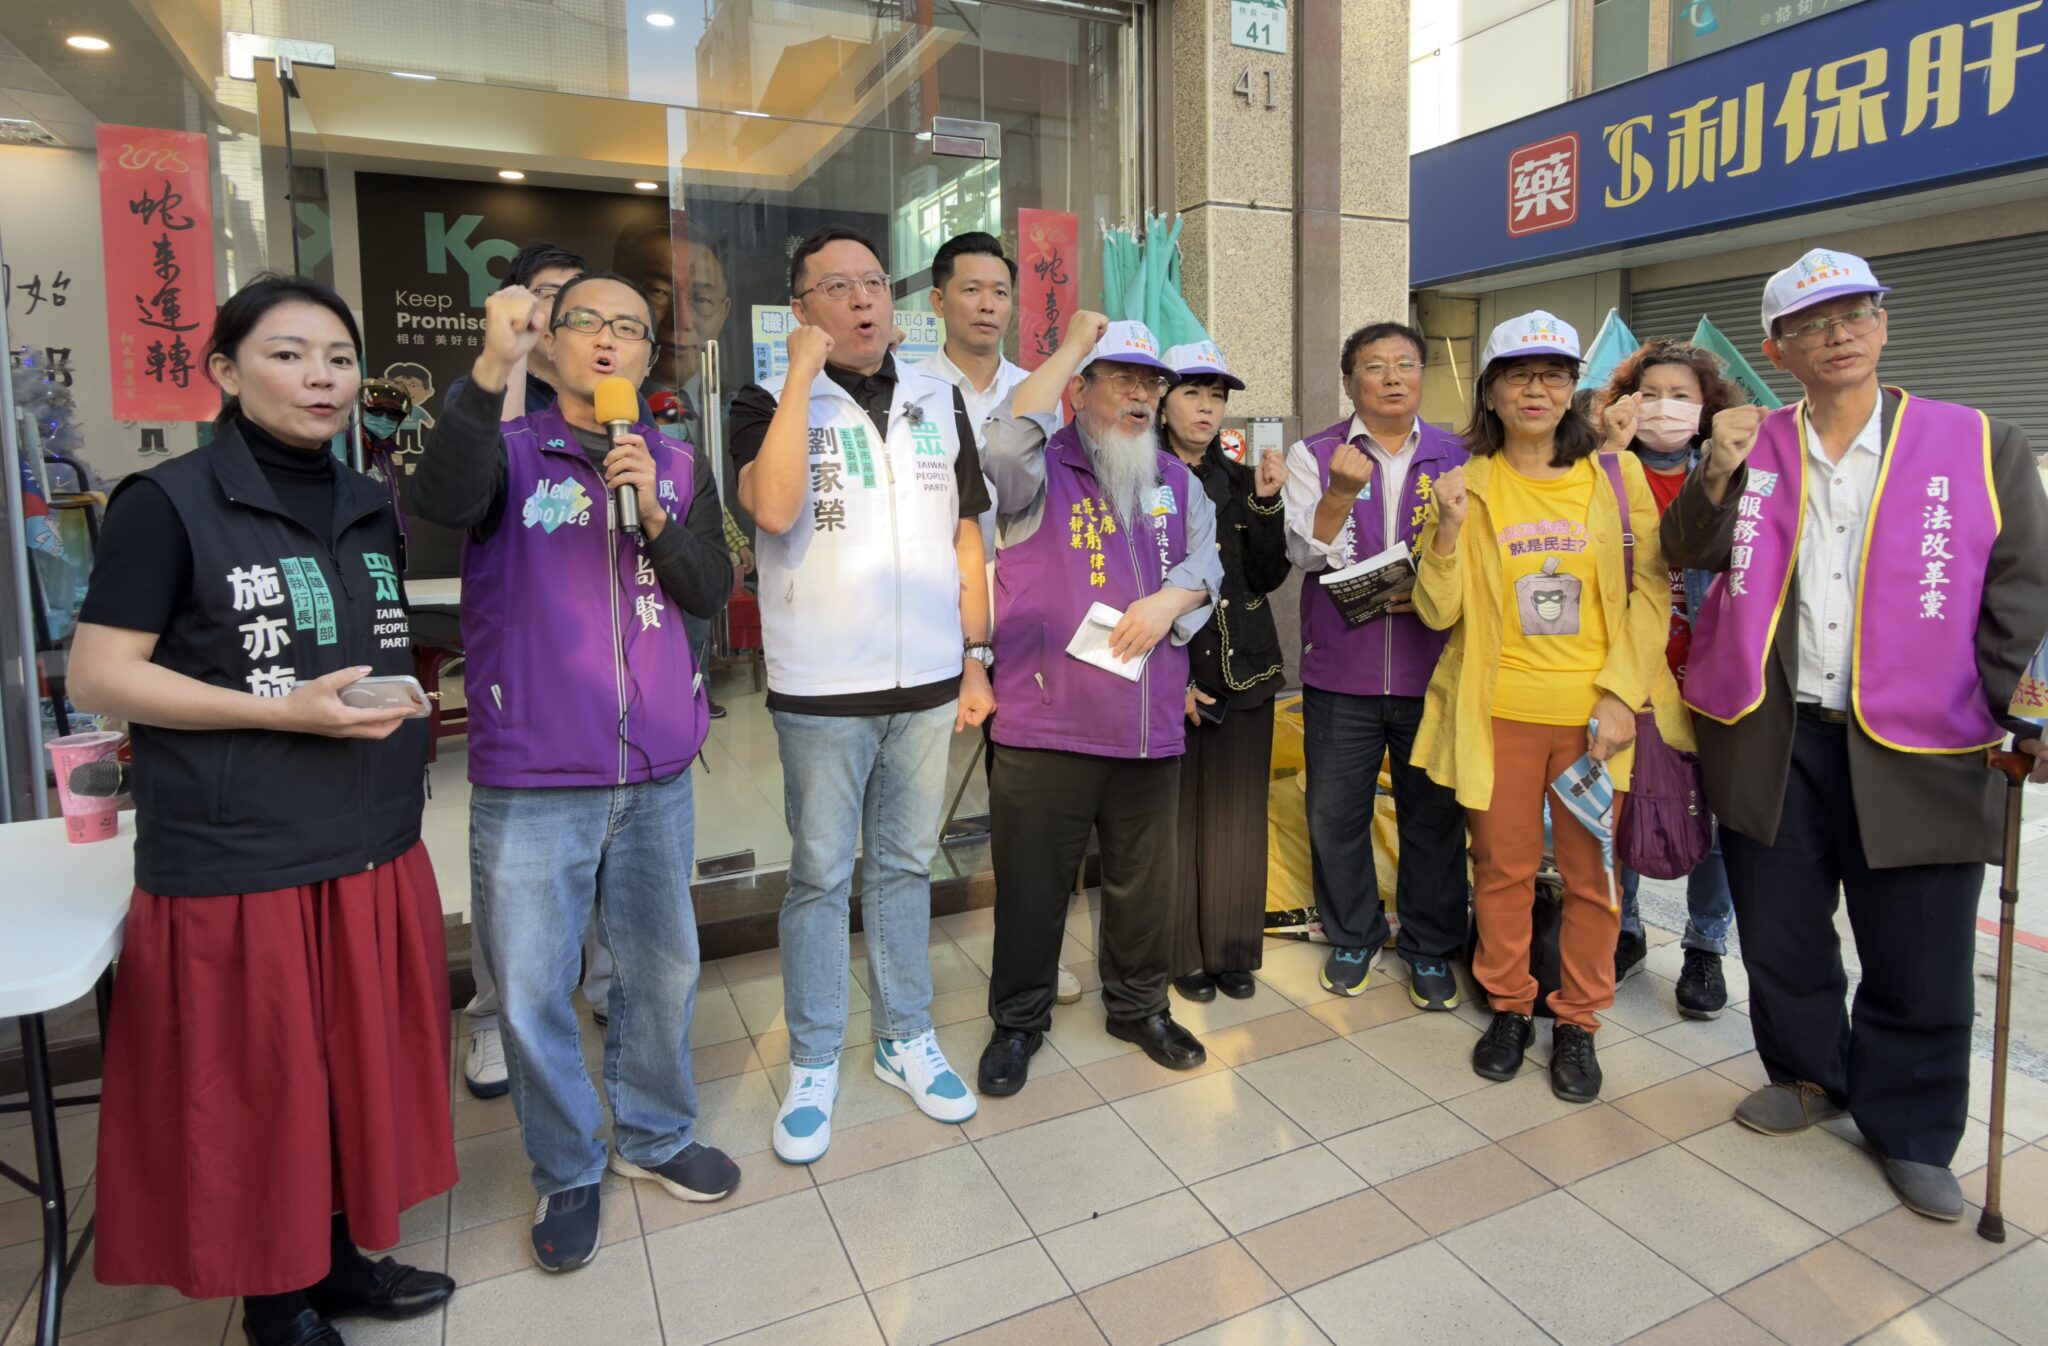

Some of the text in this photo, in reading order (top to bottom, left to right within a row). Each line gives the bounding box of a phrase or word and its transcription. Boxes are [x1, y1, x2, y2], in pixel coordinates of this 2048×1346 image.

[1246, 21, 1270, 46] 41
[1233, 63, 1279, 111] 41
[1514, 151, 1571, 222] 藥
[396, 290, 453, 312] Keep
[396, 333, 425, 345] 相信
[916, 460, 948, 470] TAIWAN
[808, 426, 846, 532] 劉家榮
[916, 472, 951, 482] PEOPLE'S
[536, 479, 573, 499] New
[923, 484, 948, 492] PARTY
[521, 500, 591, 526] Choice
[1508, 536, 1588, 556] 就是民主?
[1918, 475, 1954, 620] 司法改革黨
[376, 608, 406, 620] TAIW
